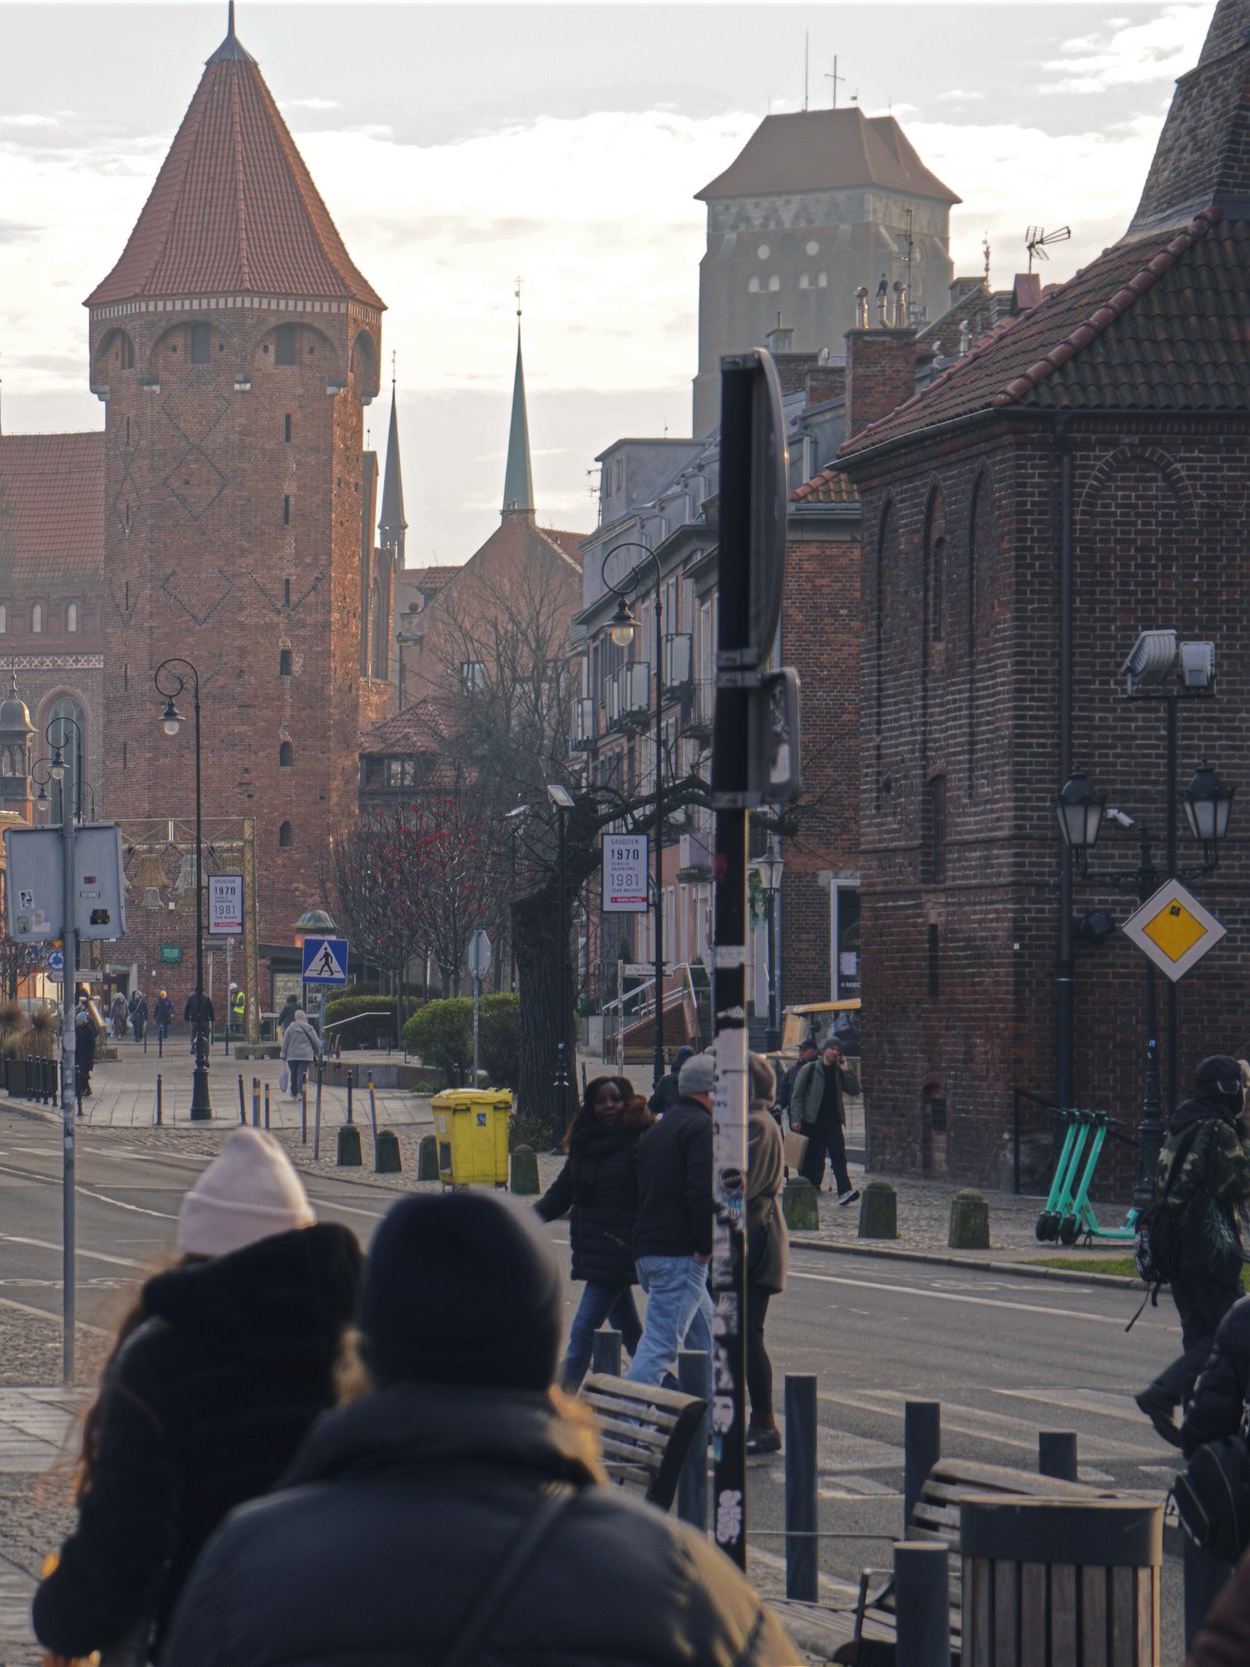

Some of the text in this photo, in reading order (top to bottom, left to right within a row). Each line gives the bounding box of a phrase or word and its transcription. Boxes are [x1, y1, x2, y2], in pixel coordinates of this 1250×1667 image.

[611, 848, 639, 860] 1970
[610, 873, 639, 887] 1981
[214, 886, 236, 895] 1970
[214, 904, 236, 915] 1981
